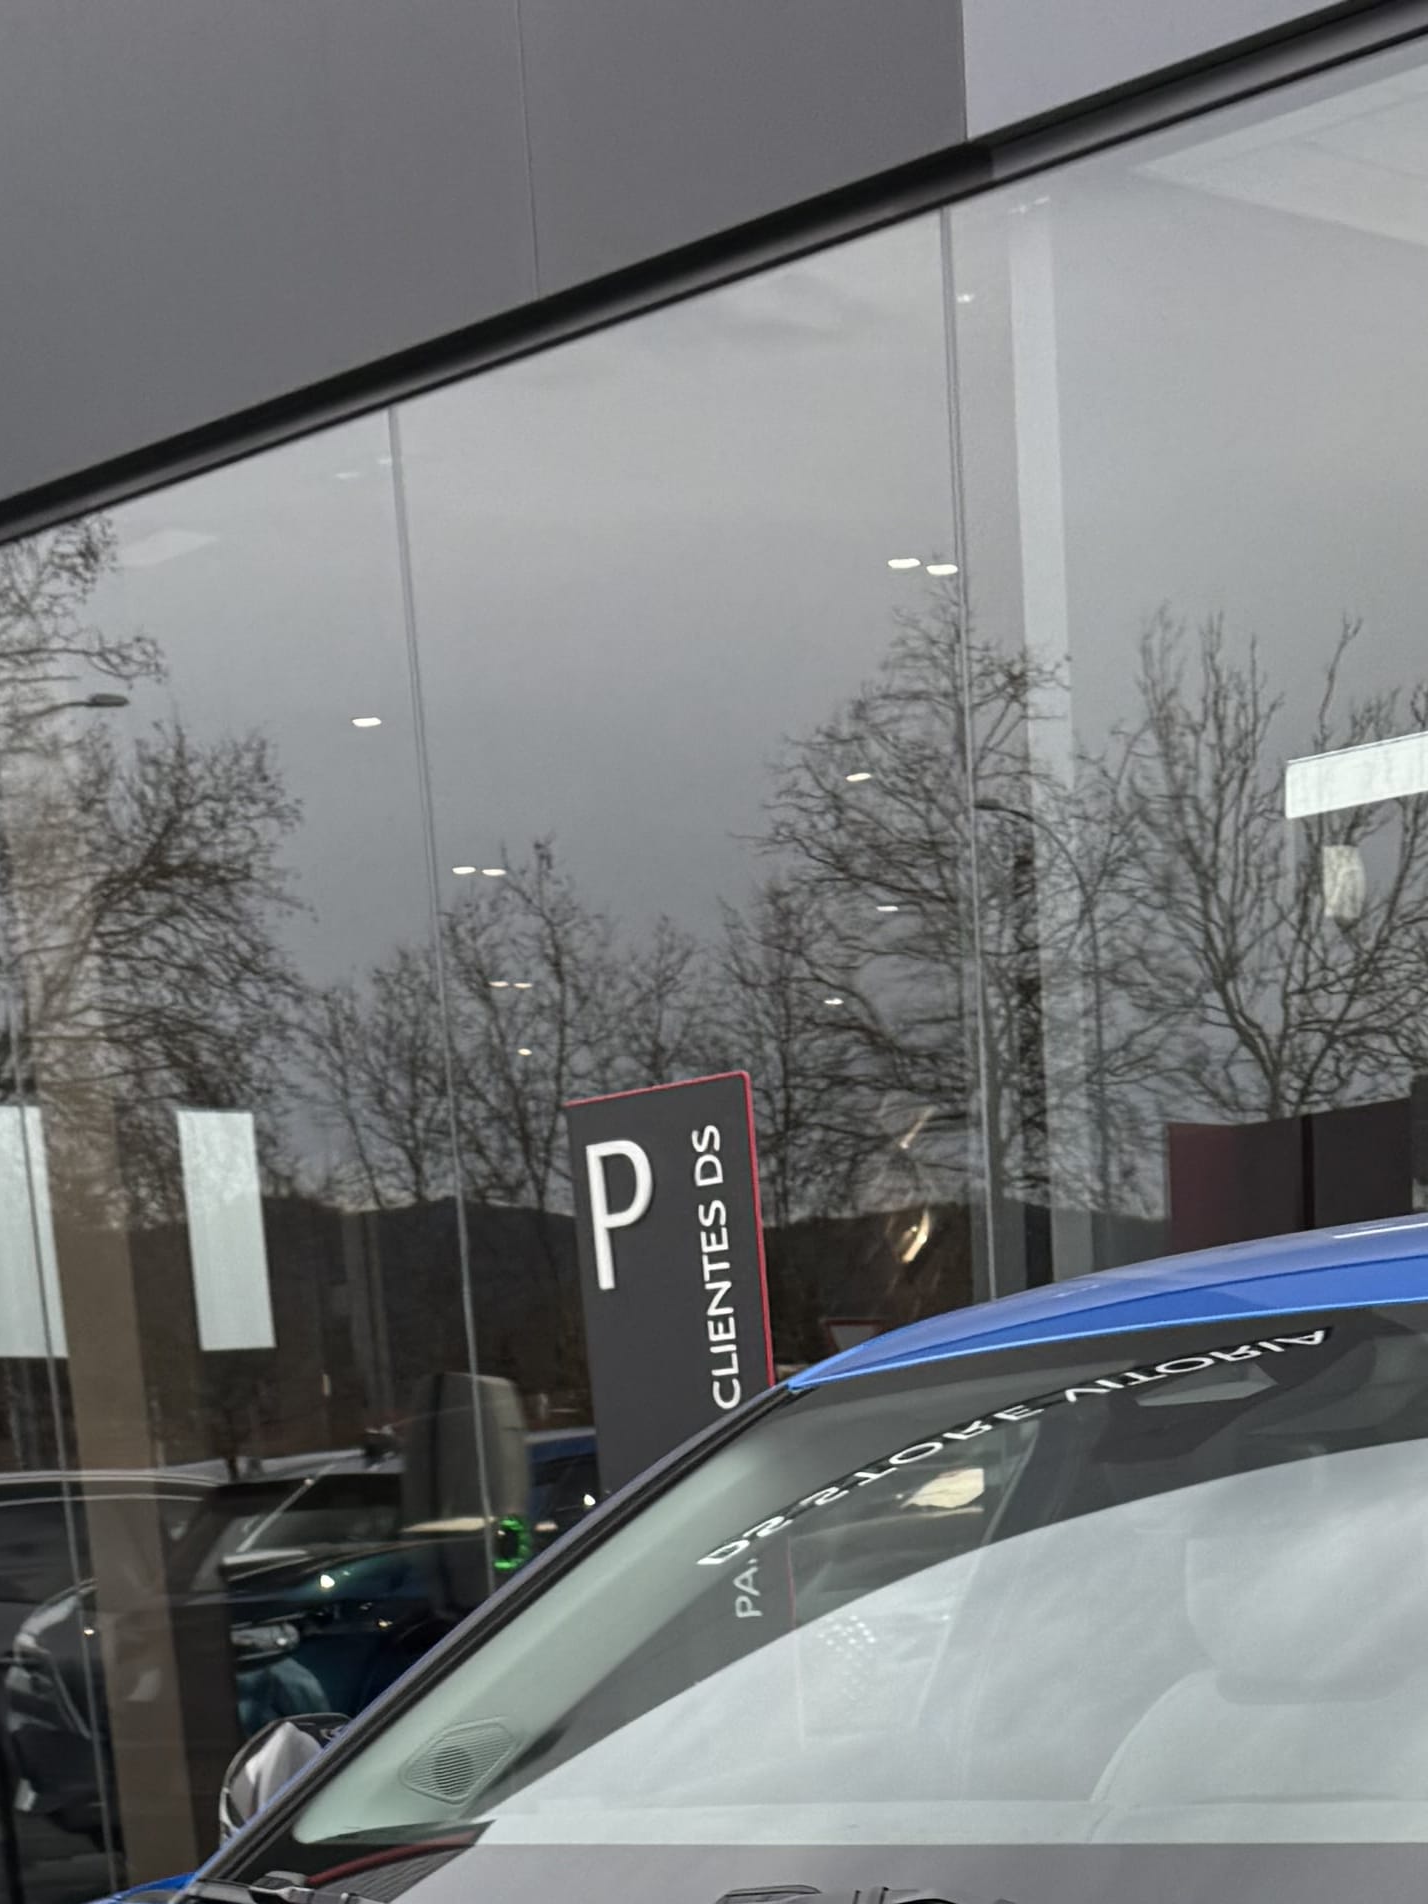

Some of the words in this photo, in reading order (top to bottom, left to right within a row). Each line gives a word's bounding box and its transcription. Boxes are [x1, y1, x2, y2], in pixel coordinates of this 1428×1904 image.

[585, 1139, 654, 1291] P
[691, 1124, 723, 1187] DS
[698, 1199, 742, 1410] CLIENTES
